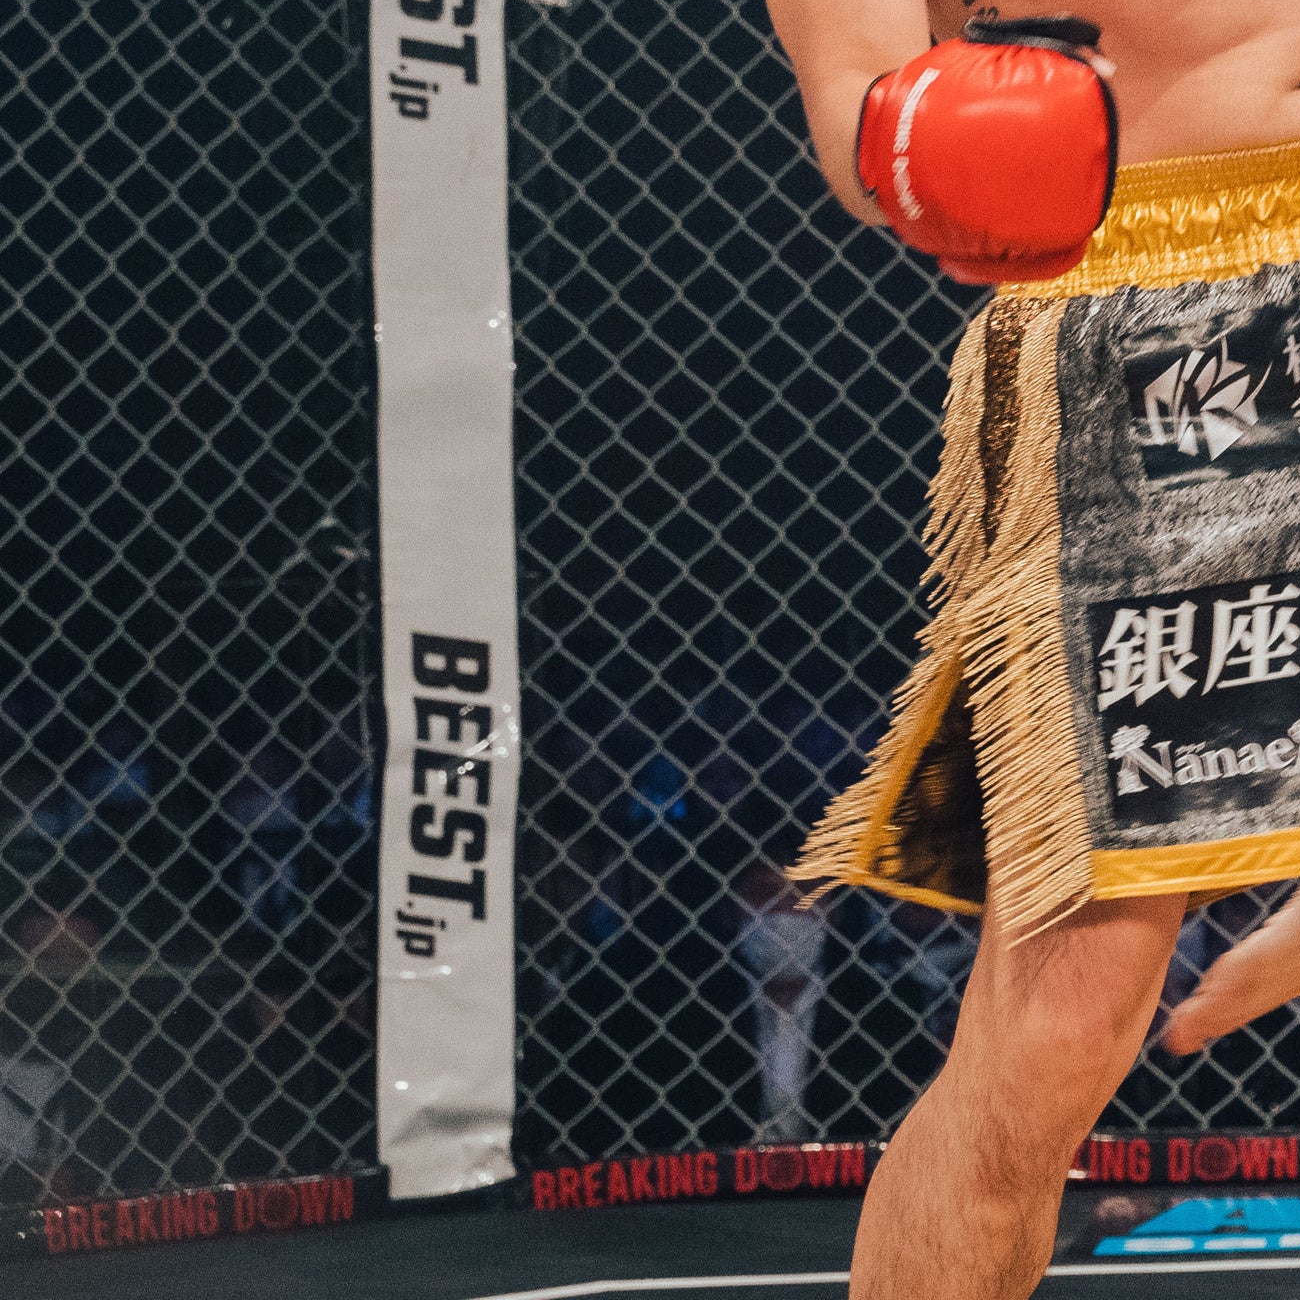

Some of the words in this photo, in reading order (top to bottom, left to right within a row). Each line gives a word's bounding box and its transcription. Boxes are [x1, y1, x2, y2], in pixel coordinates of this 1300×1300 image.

[532, 1150, 720, 1212] BREAKING
[734, 1144, 867, 1194] DOWN
[1167, 1136, 1299, 1183] DOWN
[44, 1190, 221, 1254] BREAKING
